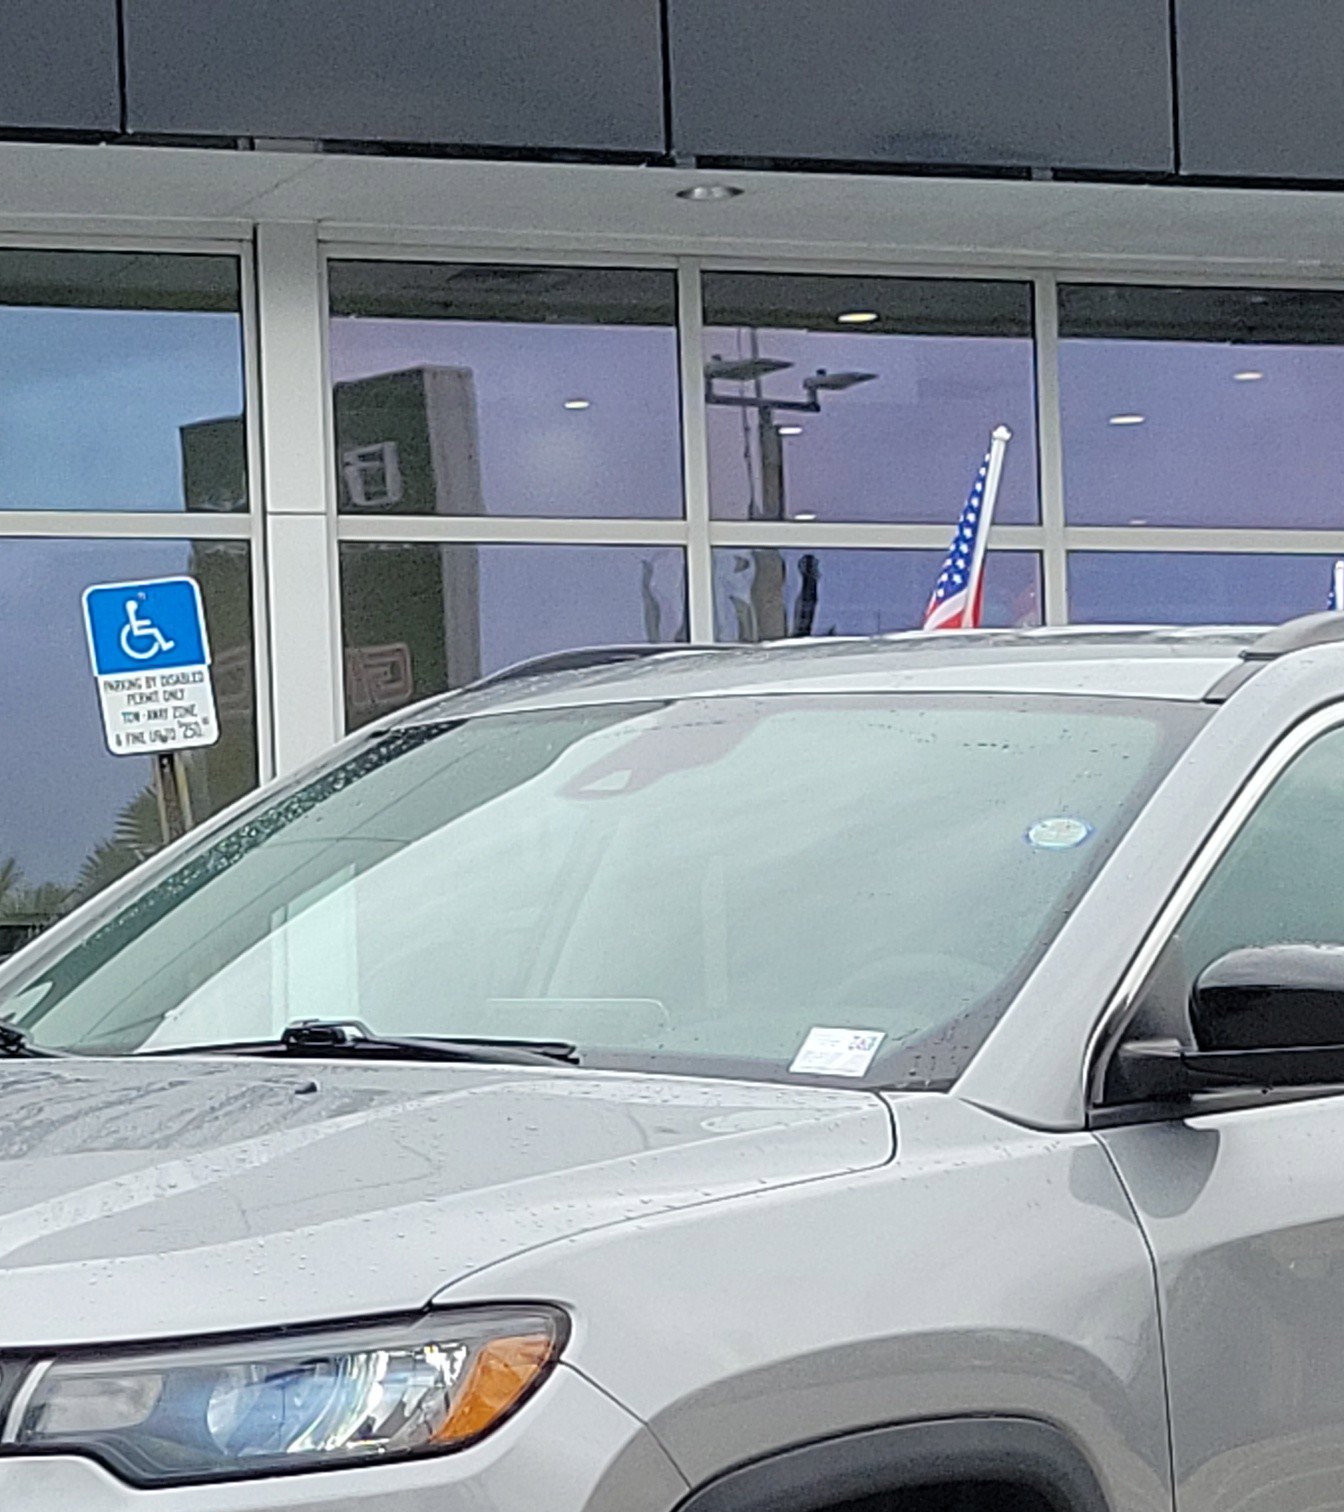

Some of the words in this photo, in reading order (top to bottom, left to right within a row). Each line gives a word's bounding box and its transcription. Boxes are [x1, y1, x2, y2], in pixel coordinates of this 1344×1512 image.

[146, 676, 156, 689] BY
[160, 671, 204, 687] DISABLED
[163, 689, 185, 702] ONLY
[172, 704, 197, 719] ZONE
